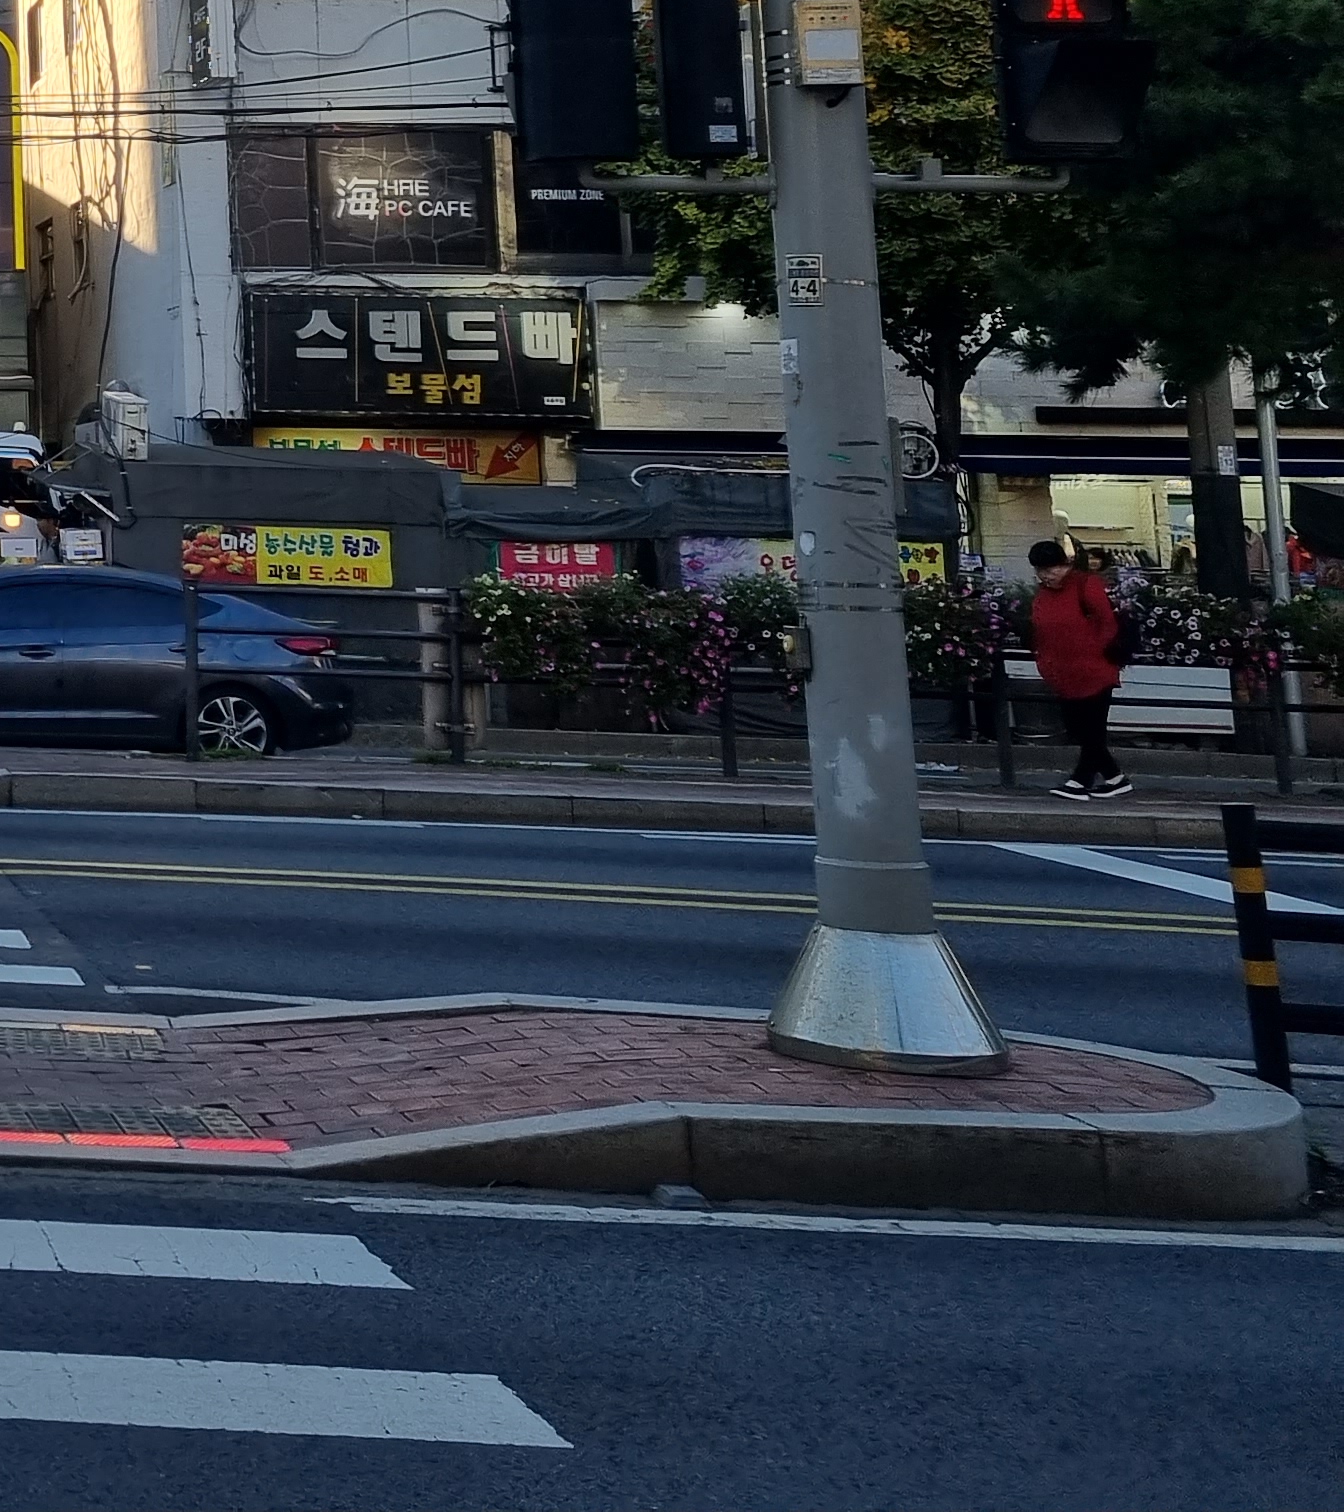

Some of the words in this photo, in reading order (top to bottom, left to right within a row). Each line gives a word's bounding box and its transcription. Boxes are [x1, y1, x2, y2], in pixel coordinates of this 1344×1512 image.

[195, 37, 207, 63] 2F
[335, 176, 380, 220] 海
[531, 189, 577, 201] PREMIUM
[579, 189, 605, 201] ZONE
[384, 201, 413, 217] PC
[418, 201, 473, 218] CAFE
[791, 279, 818, 296] 4-4
[295, 310, 578, 365] 스텐드빠
[385, 373, 482, 405] 보물섬
[264, 532, 335, 558] 농수산물
[267, 564, 301, 581] 과일
